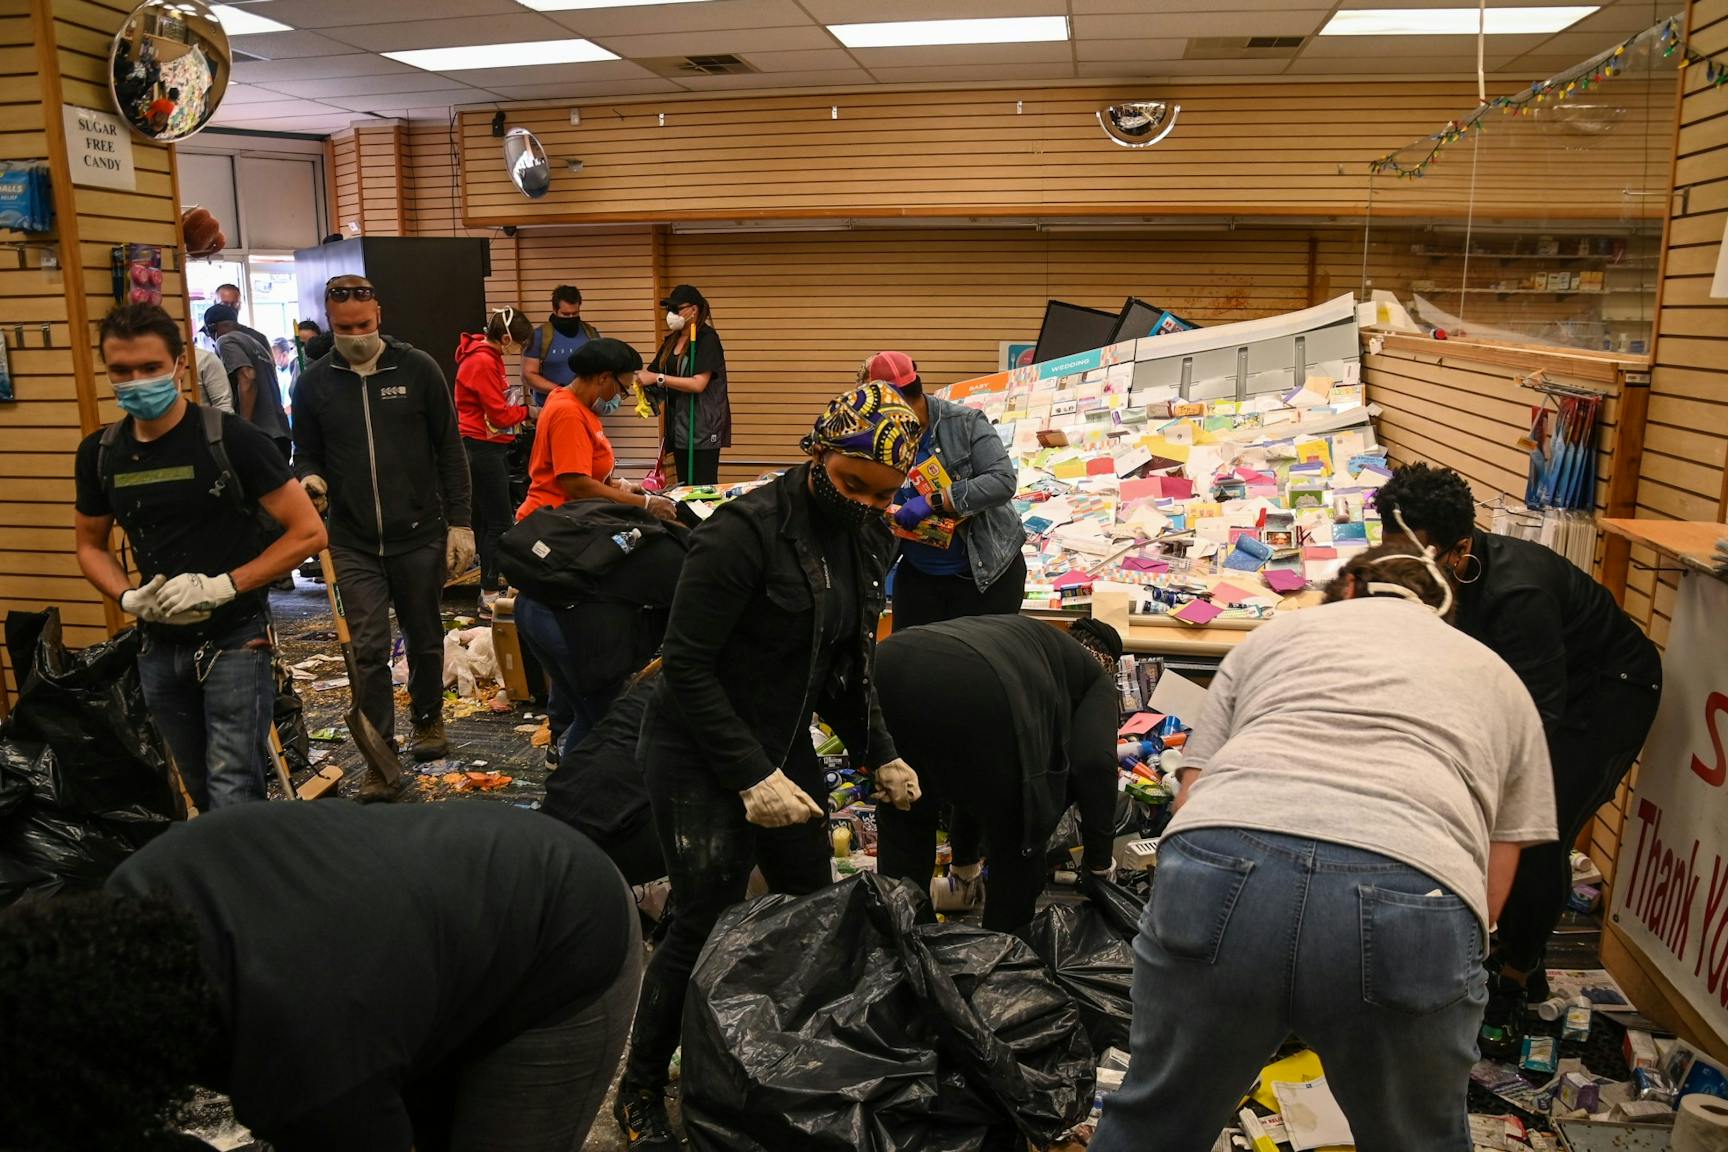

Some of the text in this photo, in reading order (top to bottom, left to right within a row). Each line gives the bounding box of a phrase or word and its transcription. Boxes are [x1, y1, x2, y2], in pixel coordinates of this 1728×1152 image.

[78, 119, 117, 136] SUGAR
[86, 138, 115, 153] FREE
[84, 156, 121, 171] CANDY
[0, 184, 23, 193] ALLS
[1051, 358, 1090, 372] WEDDING
[968, 382, 989, 391] BABY
[1625, 798, 1728, 1011] Thank Yo
